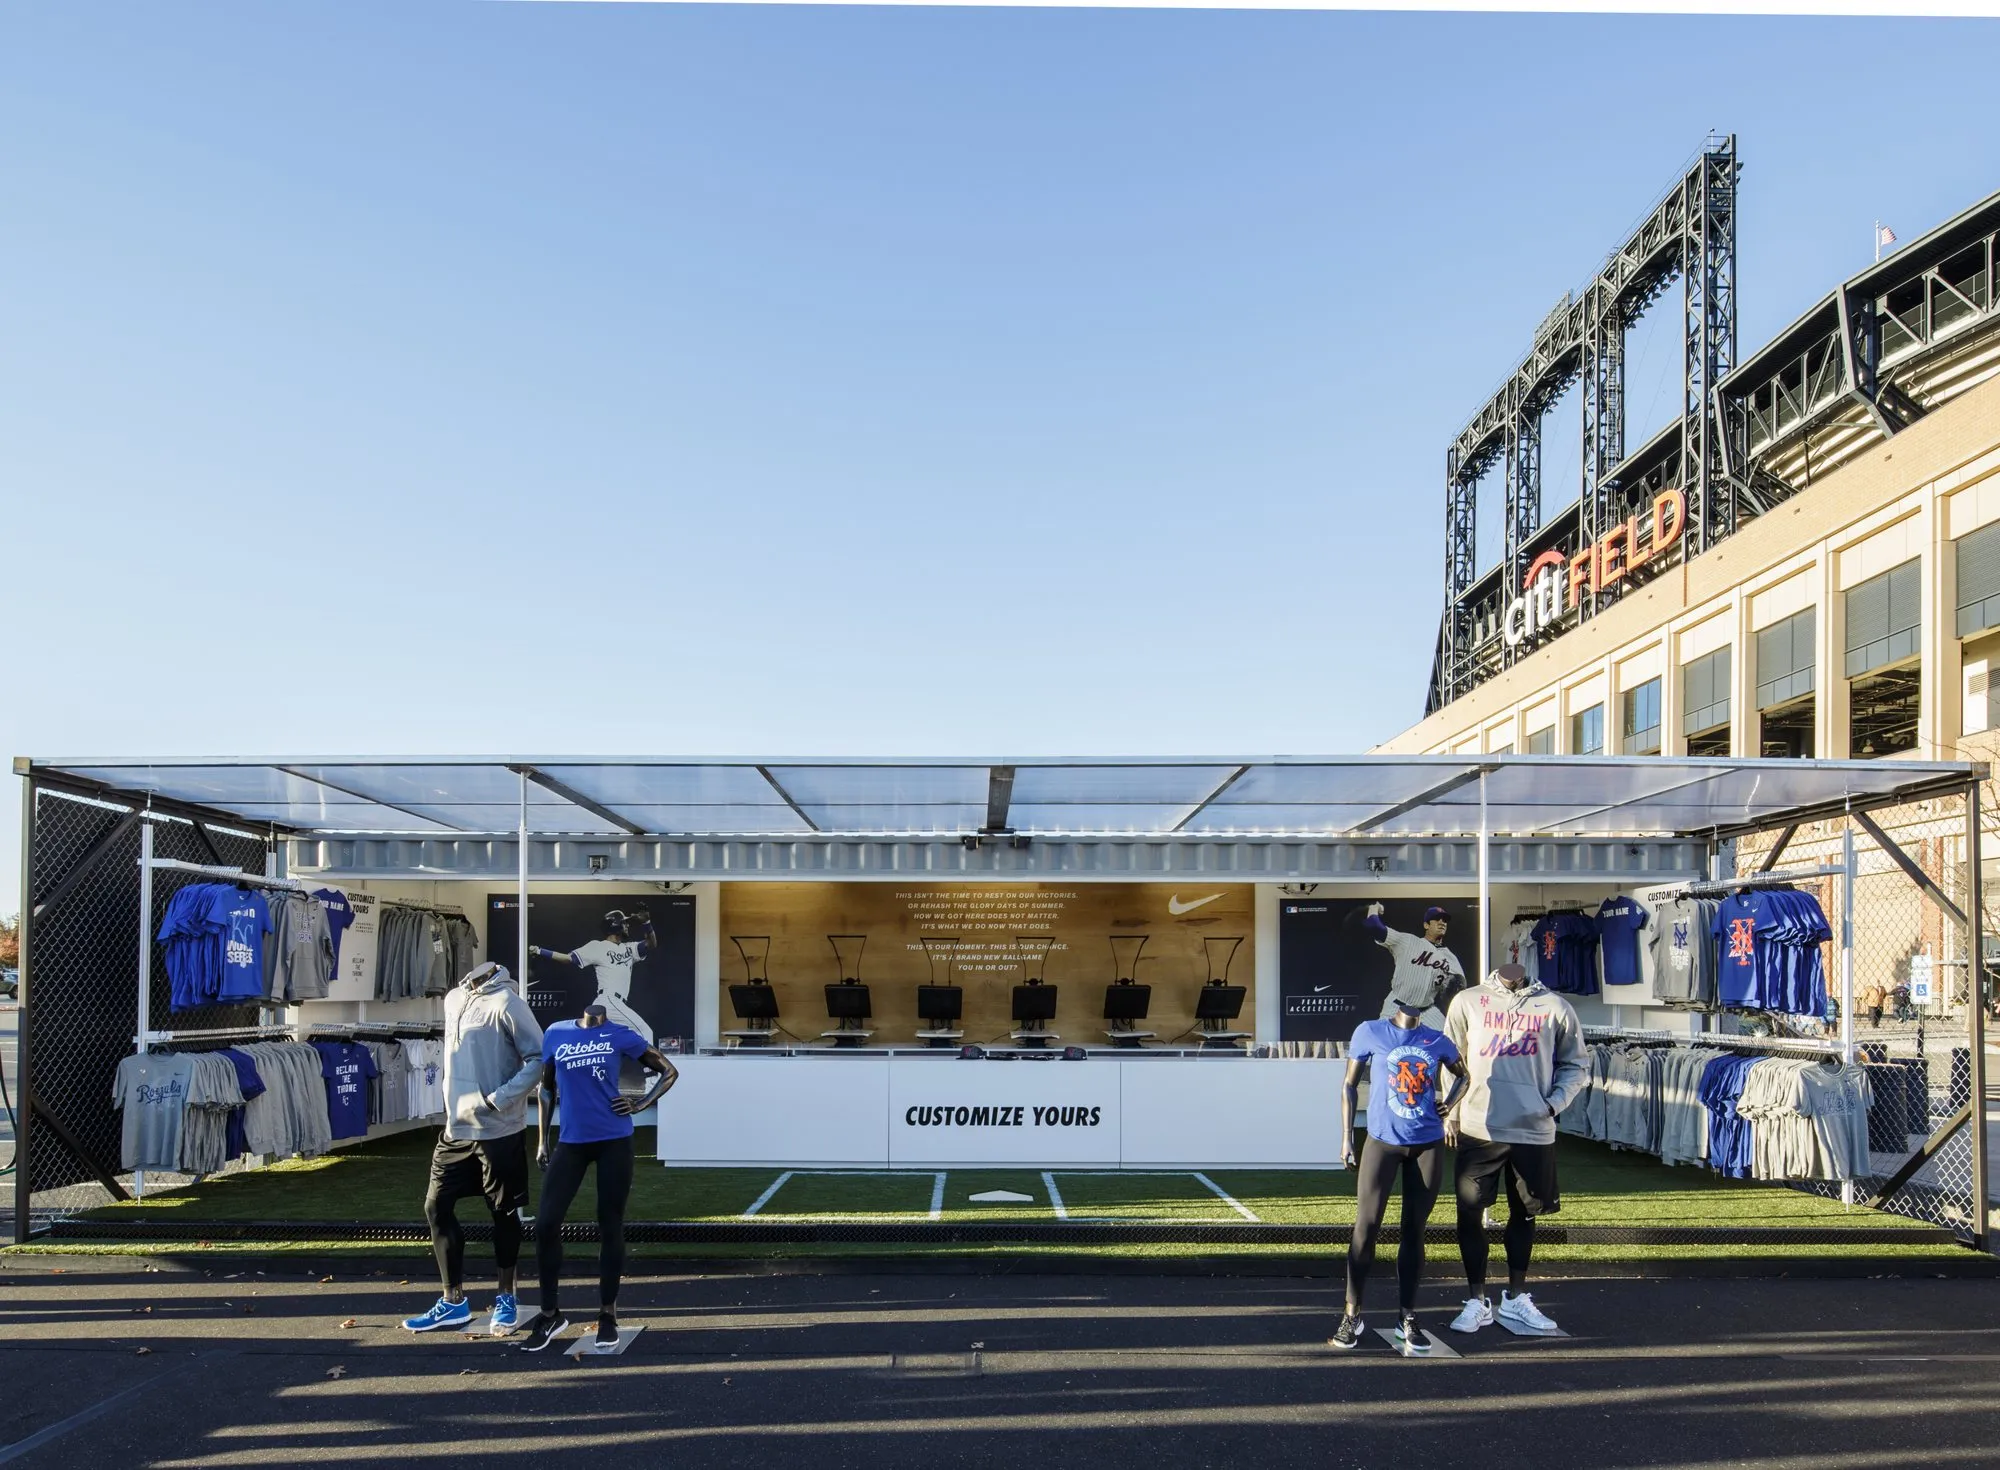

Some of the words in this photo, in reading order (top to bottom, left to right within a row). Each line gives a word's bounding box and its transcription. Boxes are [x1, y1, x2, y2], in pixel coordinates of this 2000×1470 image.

[1505, 565, 1565, 645] citi
[1568, 489, 1687, 608] FIELD
[330, 902, 344, 911] NAME
[347, 893, 376, 904] CUSTOMIZE
[353, 904, 369, 914] YOURS
[1411, 951, 1450, 972] Mets
[555, 1040, 614, 1062] October
[1480, 1034, 1538, 1056] Mets
[567, 1056, 606, 1070] BASEBALL
[592, 1066, 606, 1080] KC
[136, 1080, 181, 1104] Royals
[337, 1084, 357, 1094] THRONE
[905, 1106, 1025, 1126] CUSTOMIZE
[1033, 1106, 1101, 1126] YOURS
